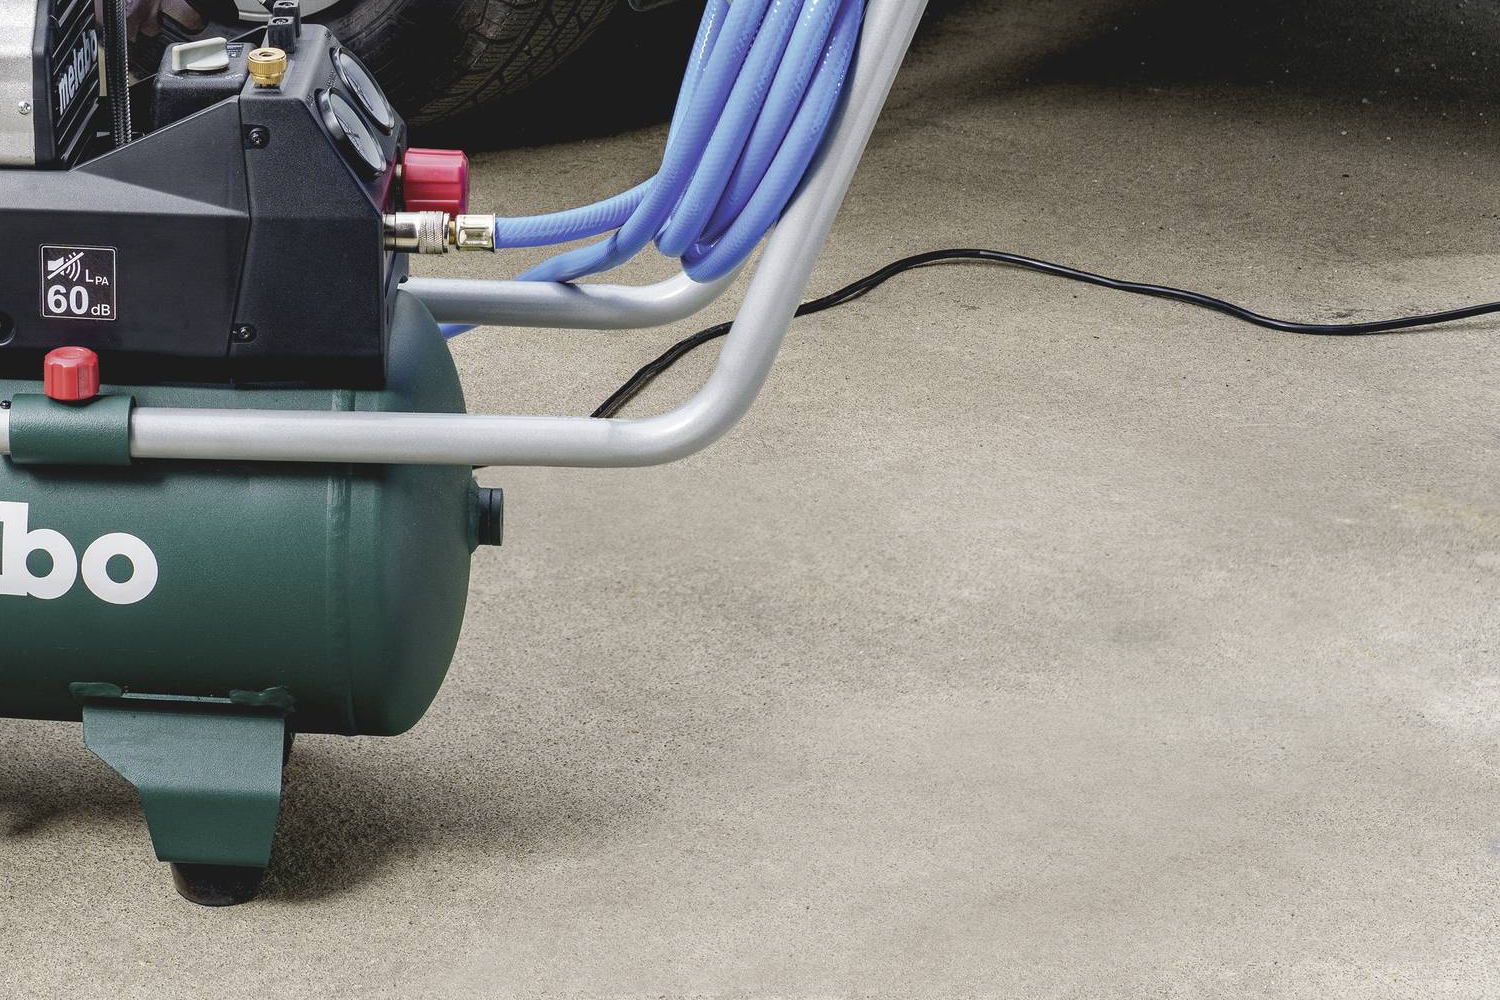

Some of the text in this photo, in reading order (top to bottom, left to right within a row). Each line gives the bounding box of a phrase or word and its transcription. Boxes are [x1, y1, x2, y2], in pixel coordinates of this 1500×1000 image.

[58, 29, 98, 116] metabo
[47, 284, 111, 316] 60 dB
